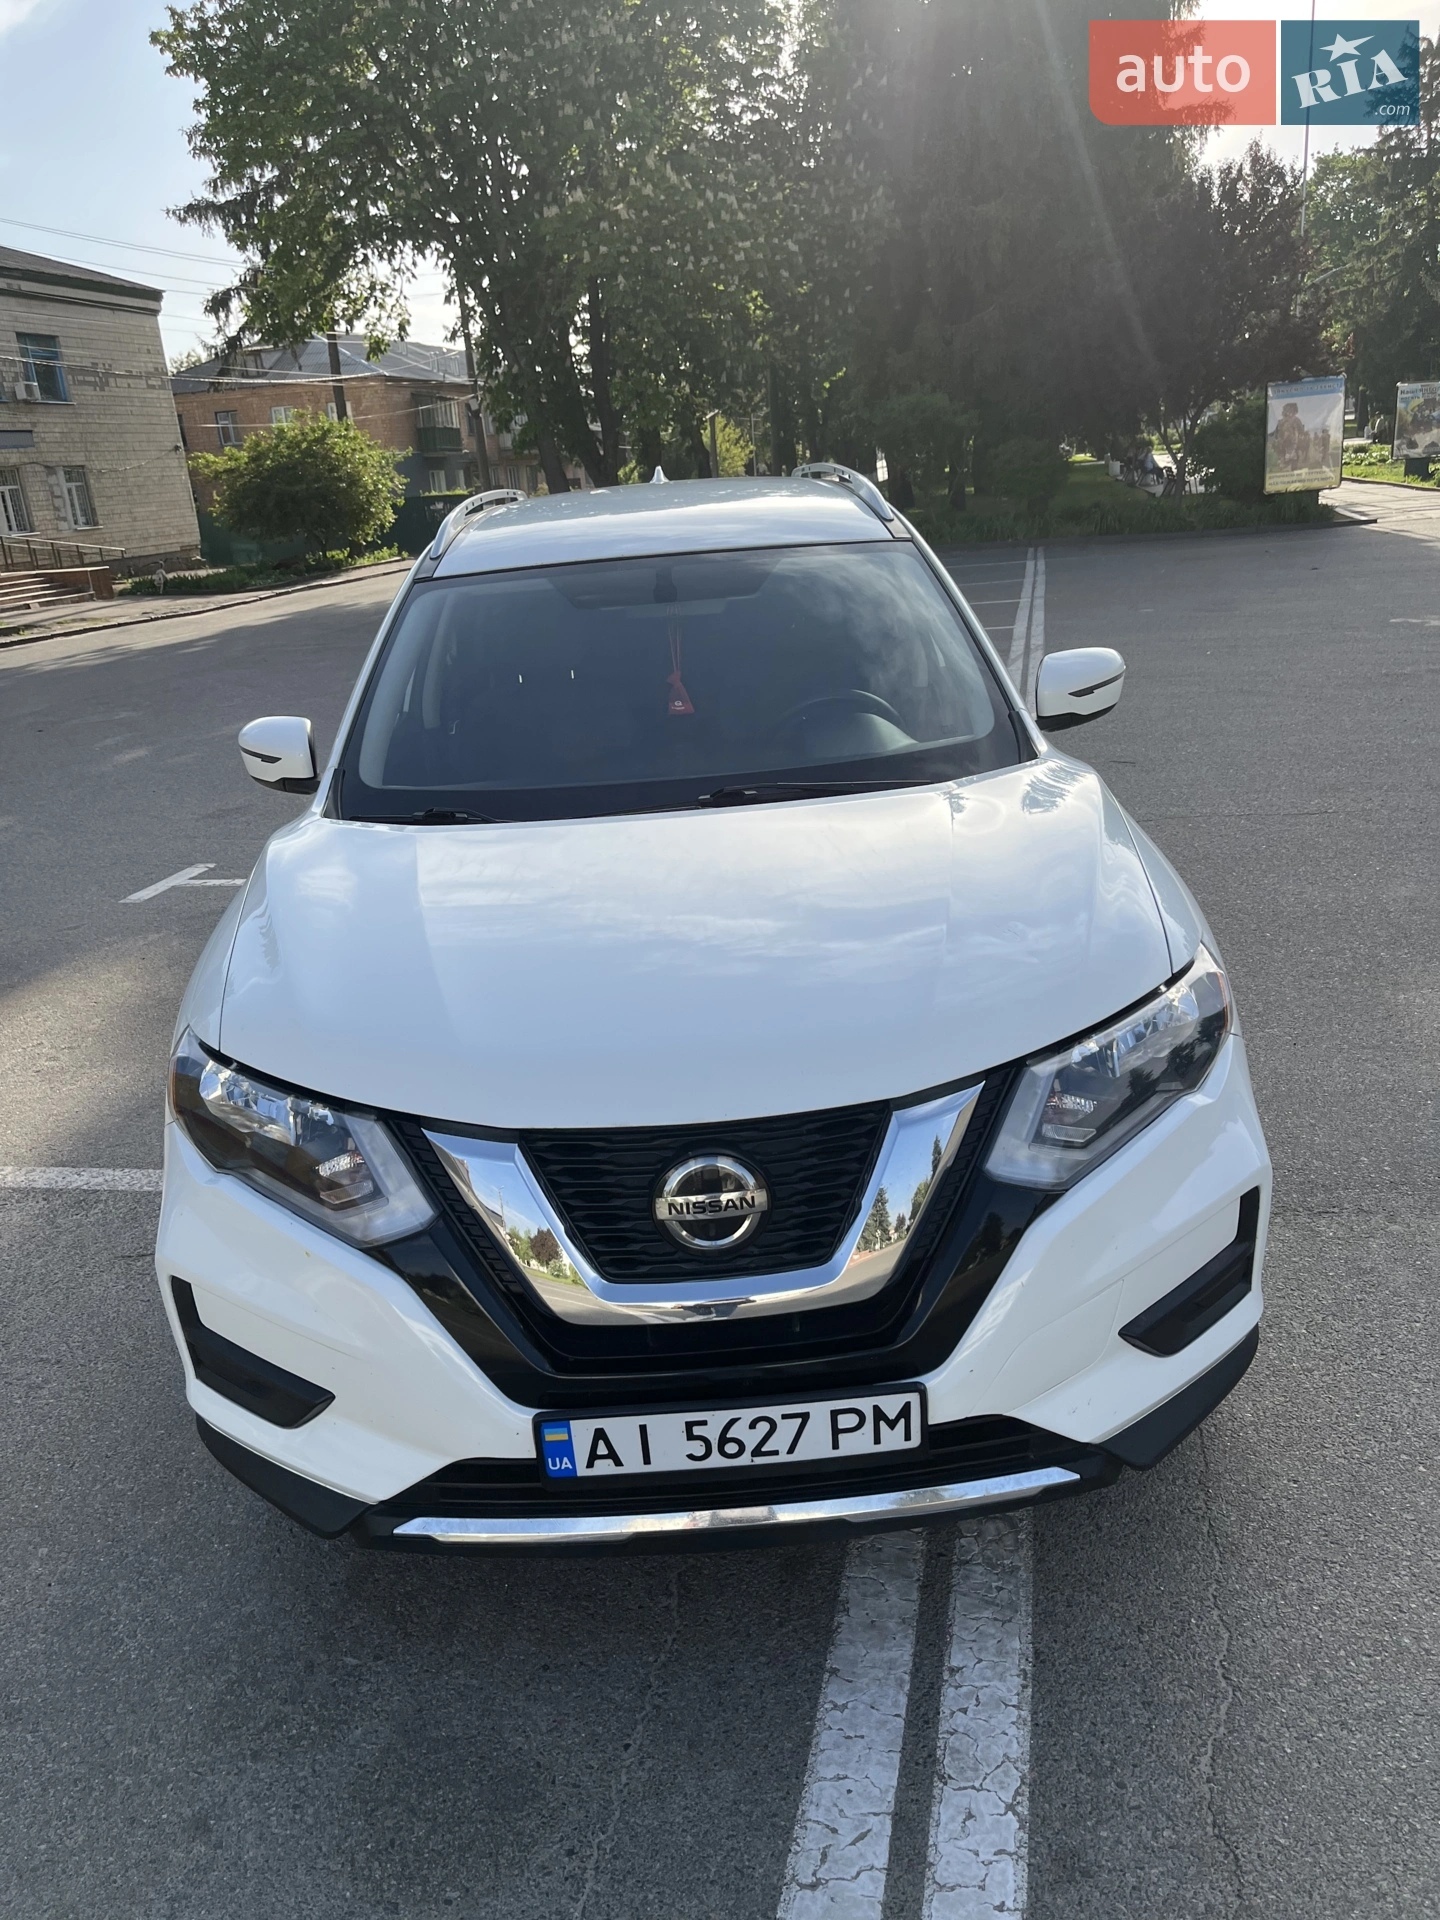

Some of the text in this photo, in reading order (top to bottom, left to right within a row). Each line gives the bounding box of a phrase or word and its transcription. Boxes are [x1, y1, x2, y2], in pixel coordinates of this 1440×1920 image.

[668, 1196, 756, 1216] NISSAN
[586, 1401, 912, 1469] AI 5627 PM
[548, 1457, 573, 1470] UA
